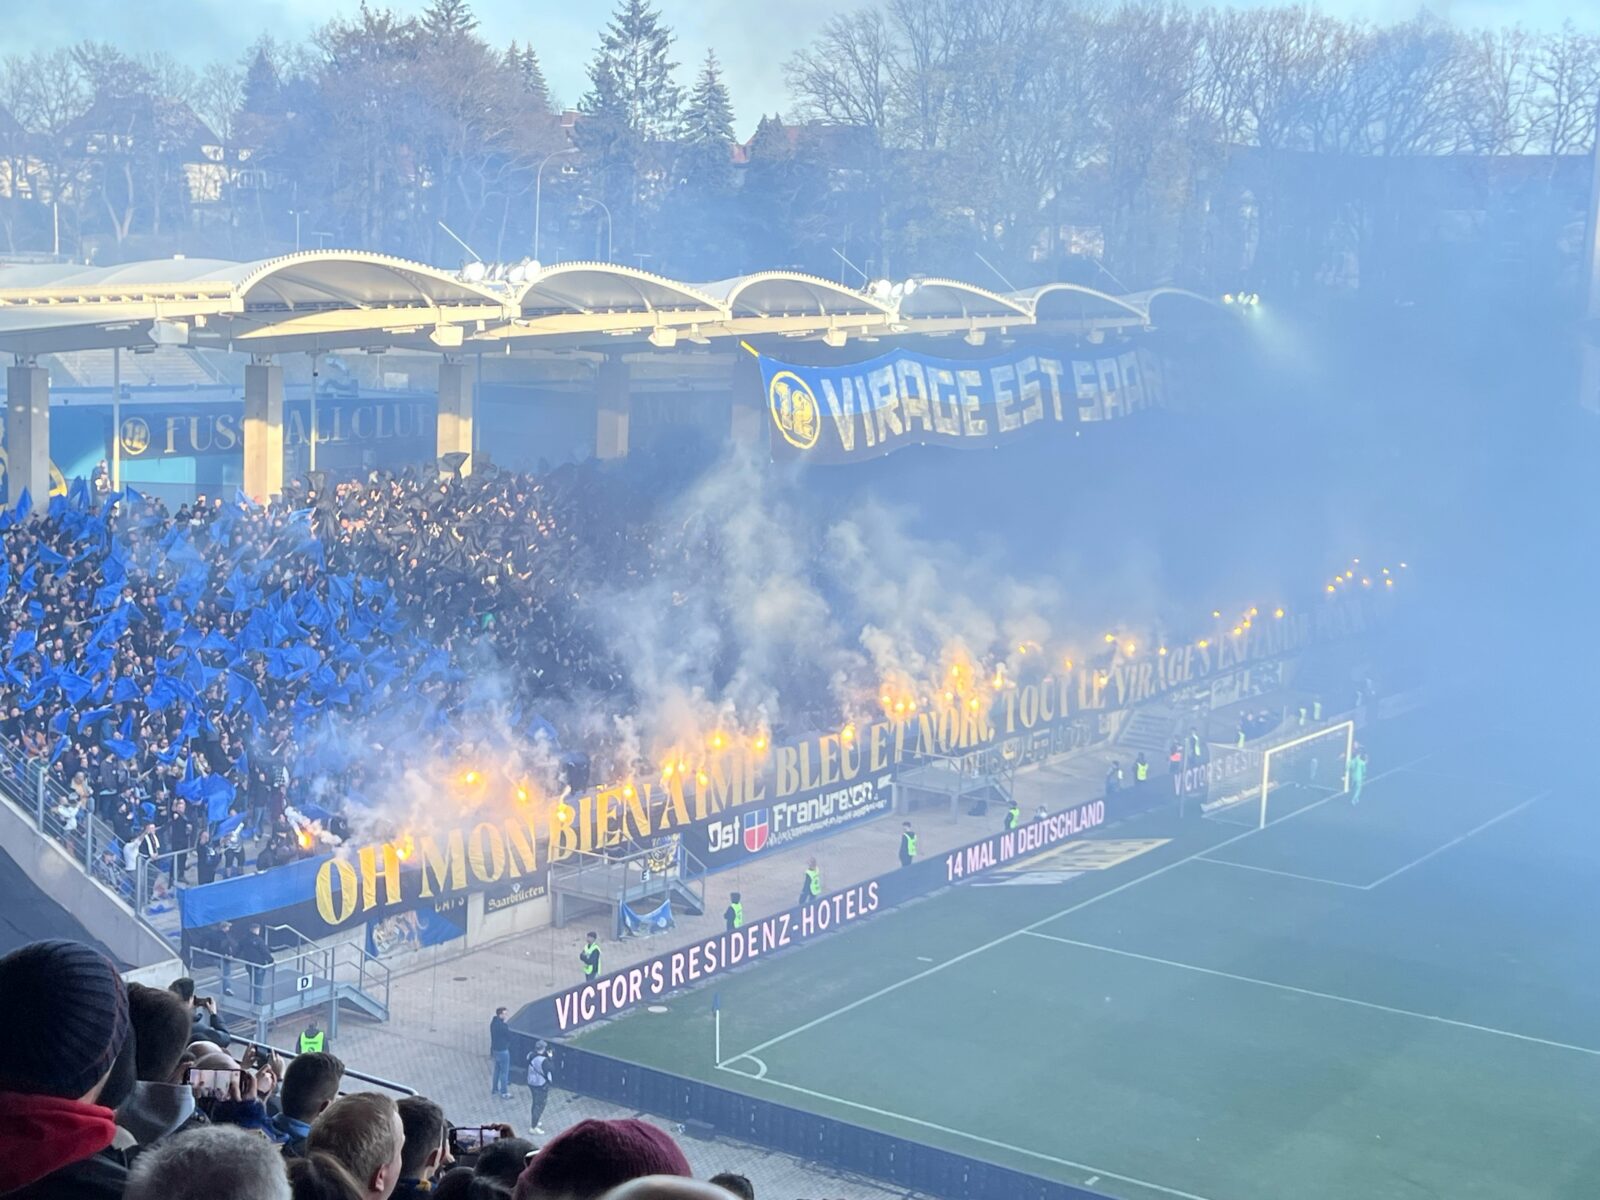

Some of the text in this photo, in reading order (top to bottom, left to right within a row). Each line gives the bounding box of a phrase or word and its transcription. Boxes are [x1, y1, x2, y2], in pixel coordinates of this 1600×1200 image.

[820, 358, 988, 451] VIRAGE
[990, 356, 1063, 433] EST
[316, 842, 402, 926] OH
[419, 818, 537, 898] MON
[776, 732, 862, 798] BLEU
[869, 715, 909, 773] ET
[1003, 666, 1072, 733] TOUT
[1078, 668, 1105, 710] LE
[946, 800, 1105, 881] 14 MAL IN DEUTSCHLAND
[301, 977, 309, 988] D
[555, 881, 879, 1030] VICTOR'S RESIDENZ-HOTELS
